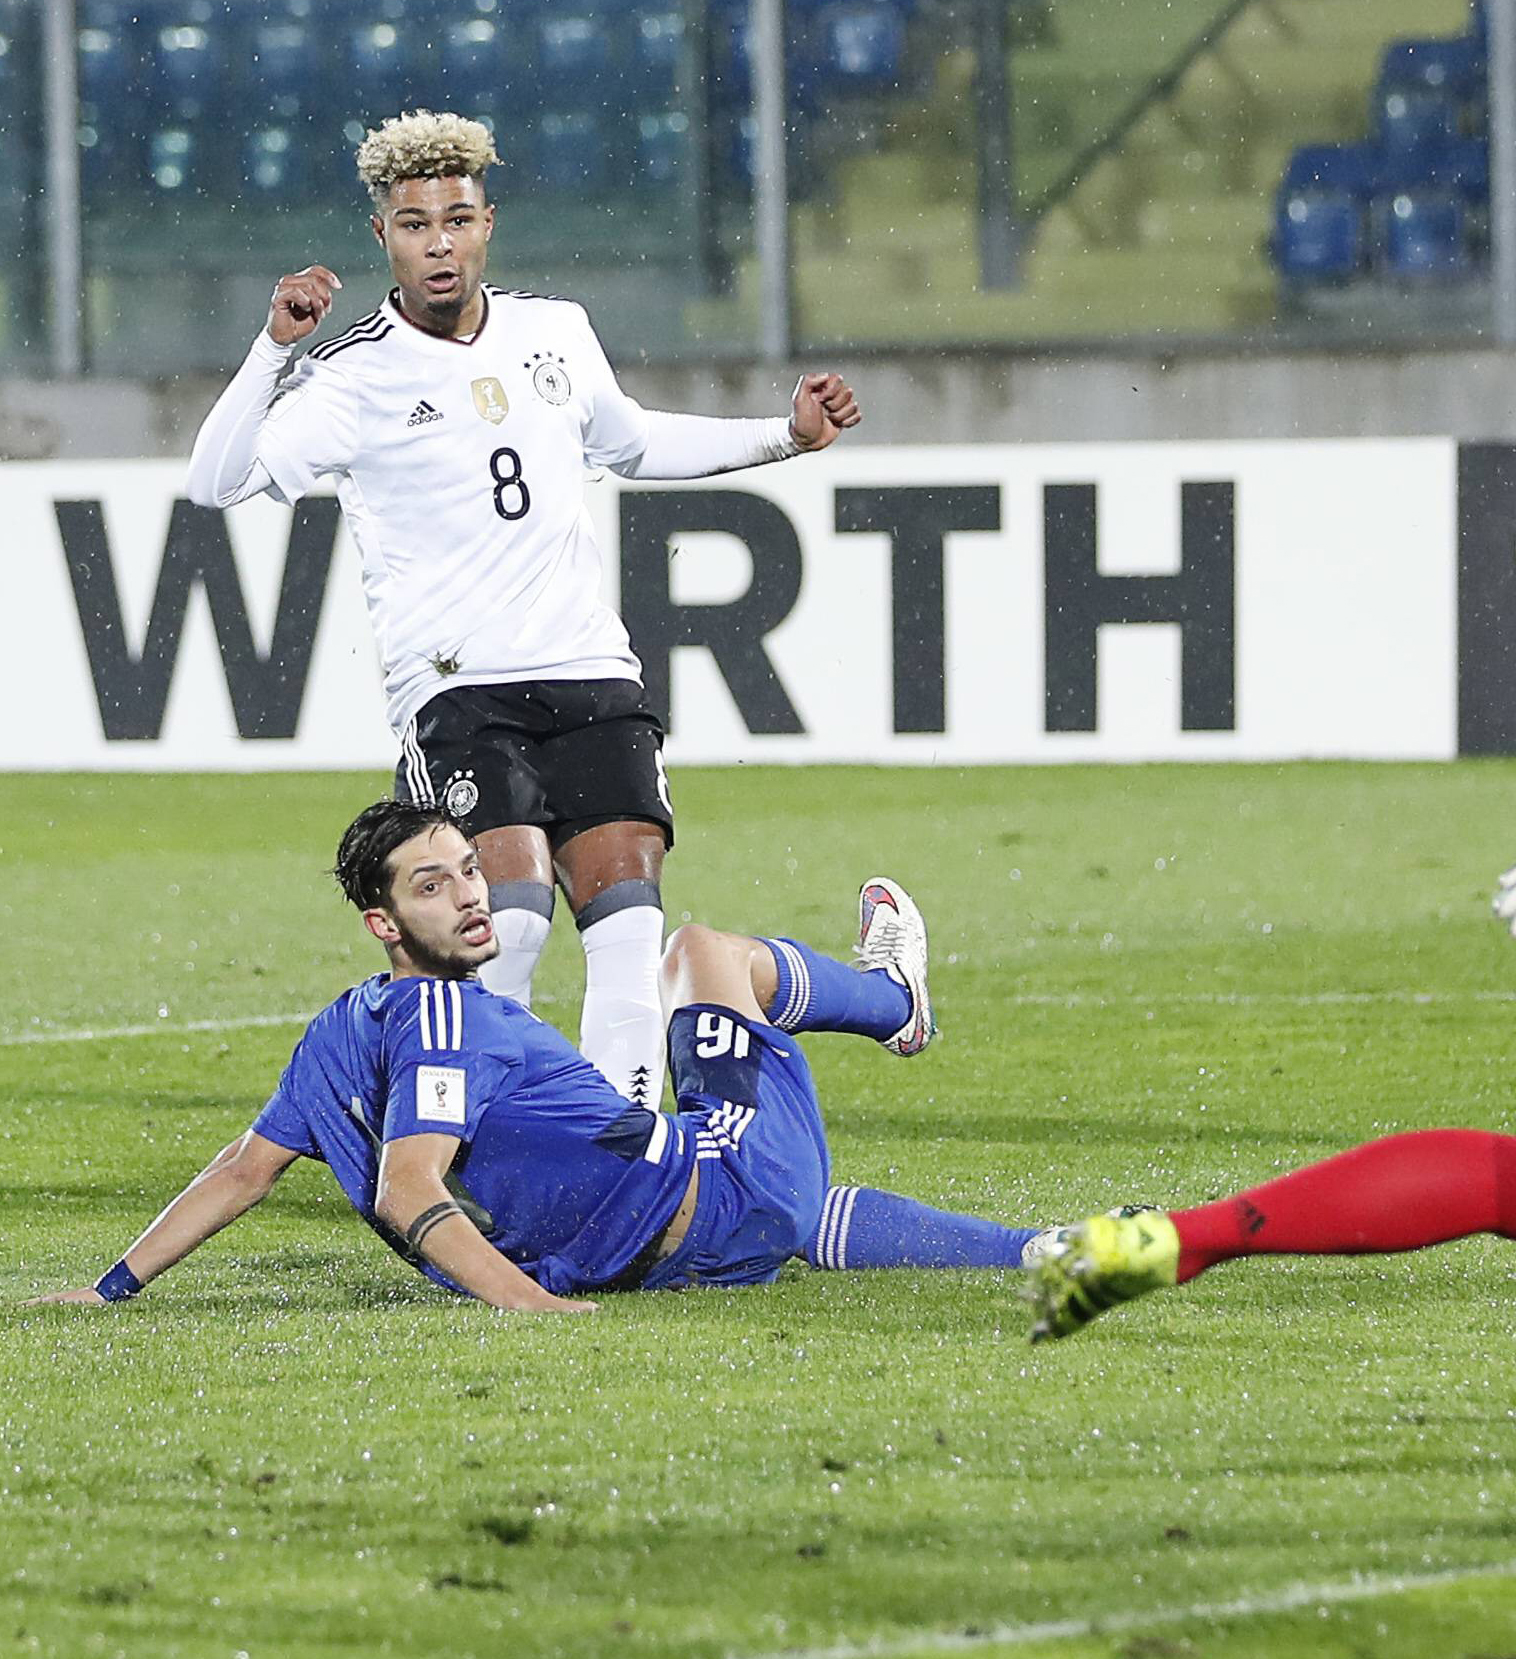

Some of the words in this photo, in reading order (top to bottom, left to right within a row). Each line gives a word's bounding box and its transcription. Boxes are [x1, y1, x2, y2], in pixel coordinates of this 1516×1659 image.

[407, 411, 445, 427] adidas
[489, 446, 531, 521] 8
[53, 481, 1236, 741] WRTH
